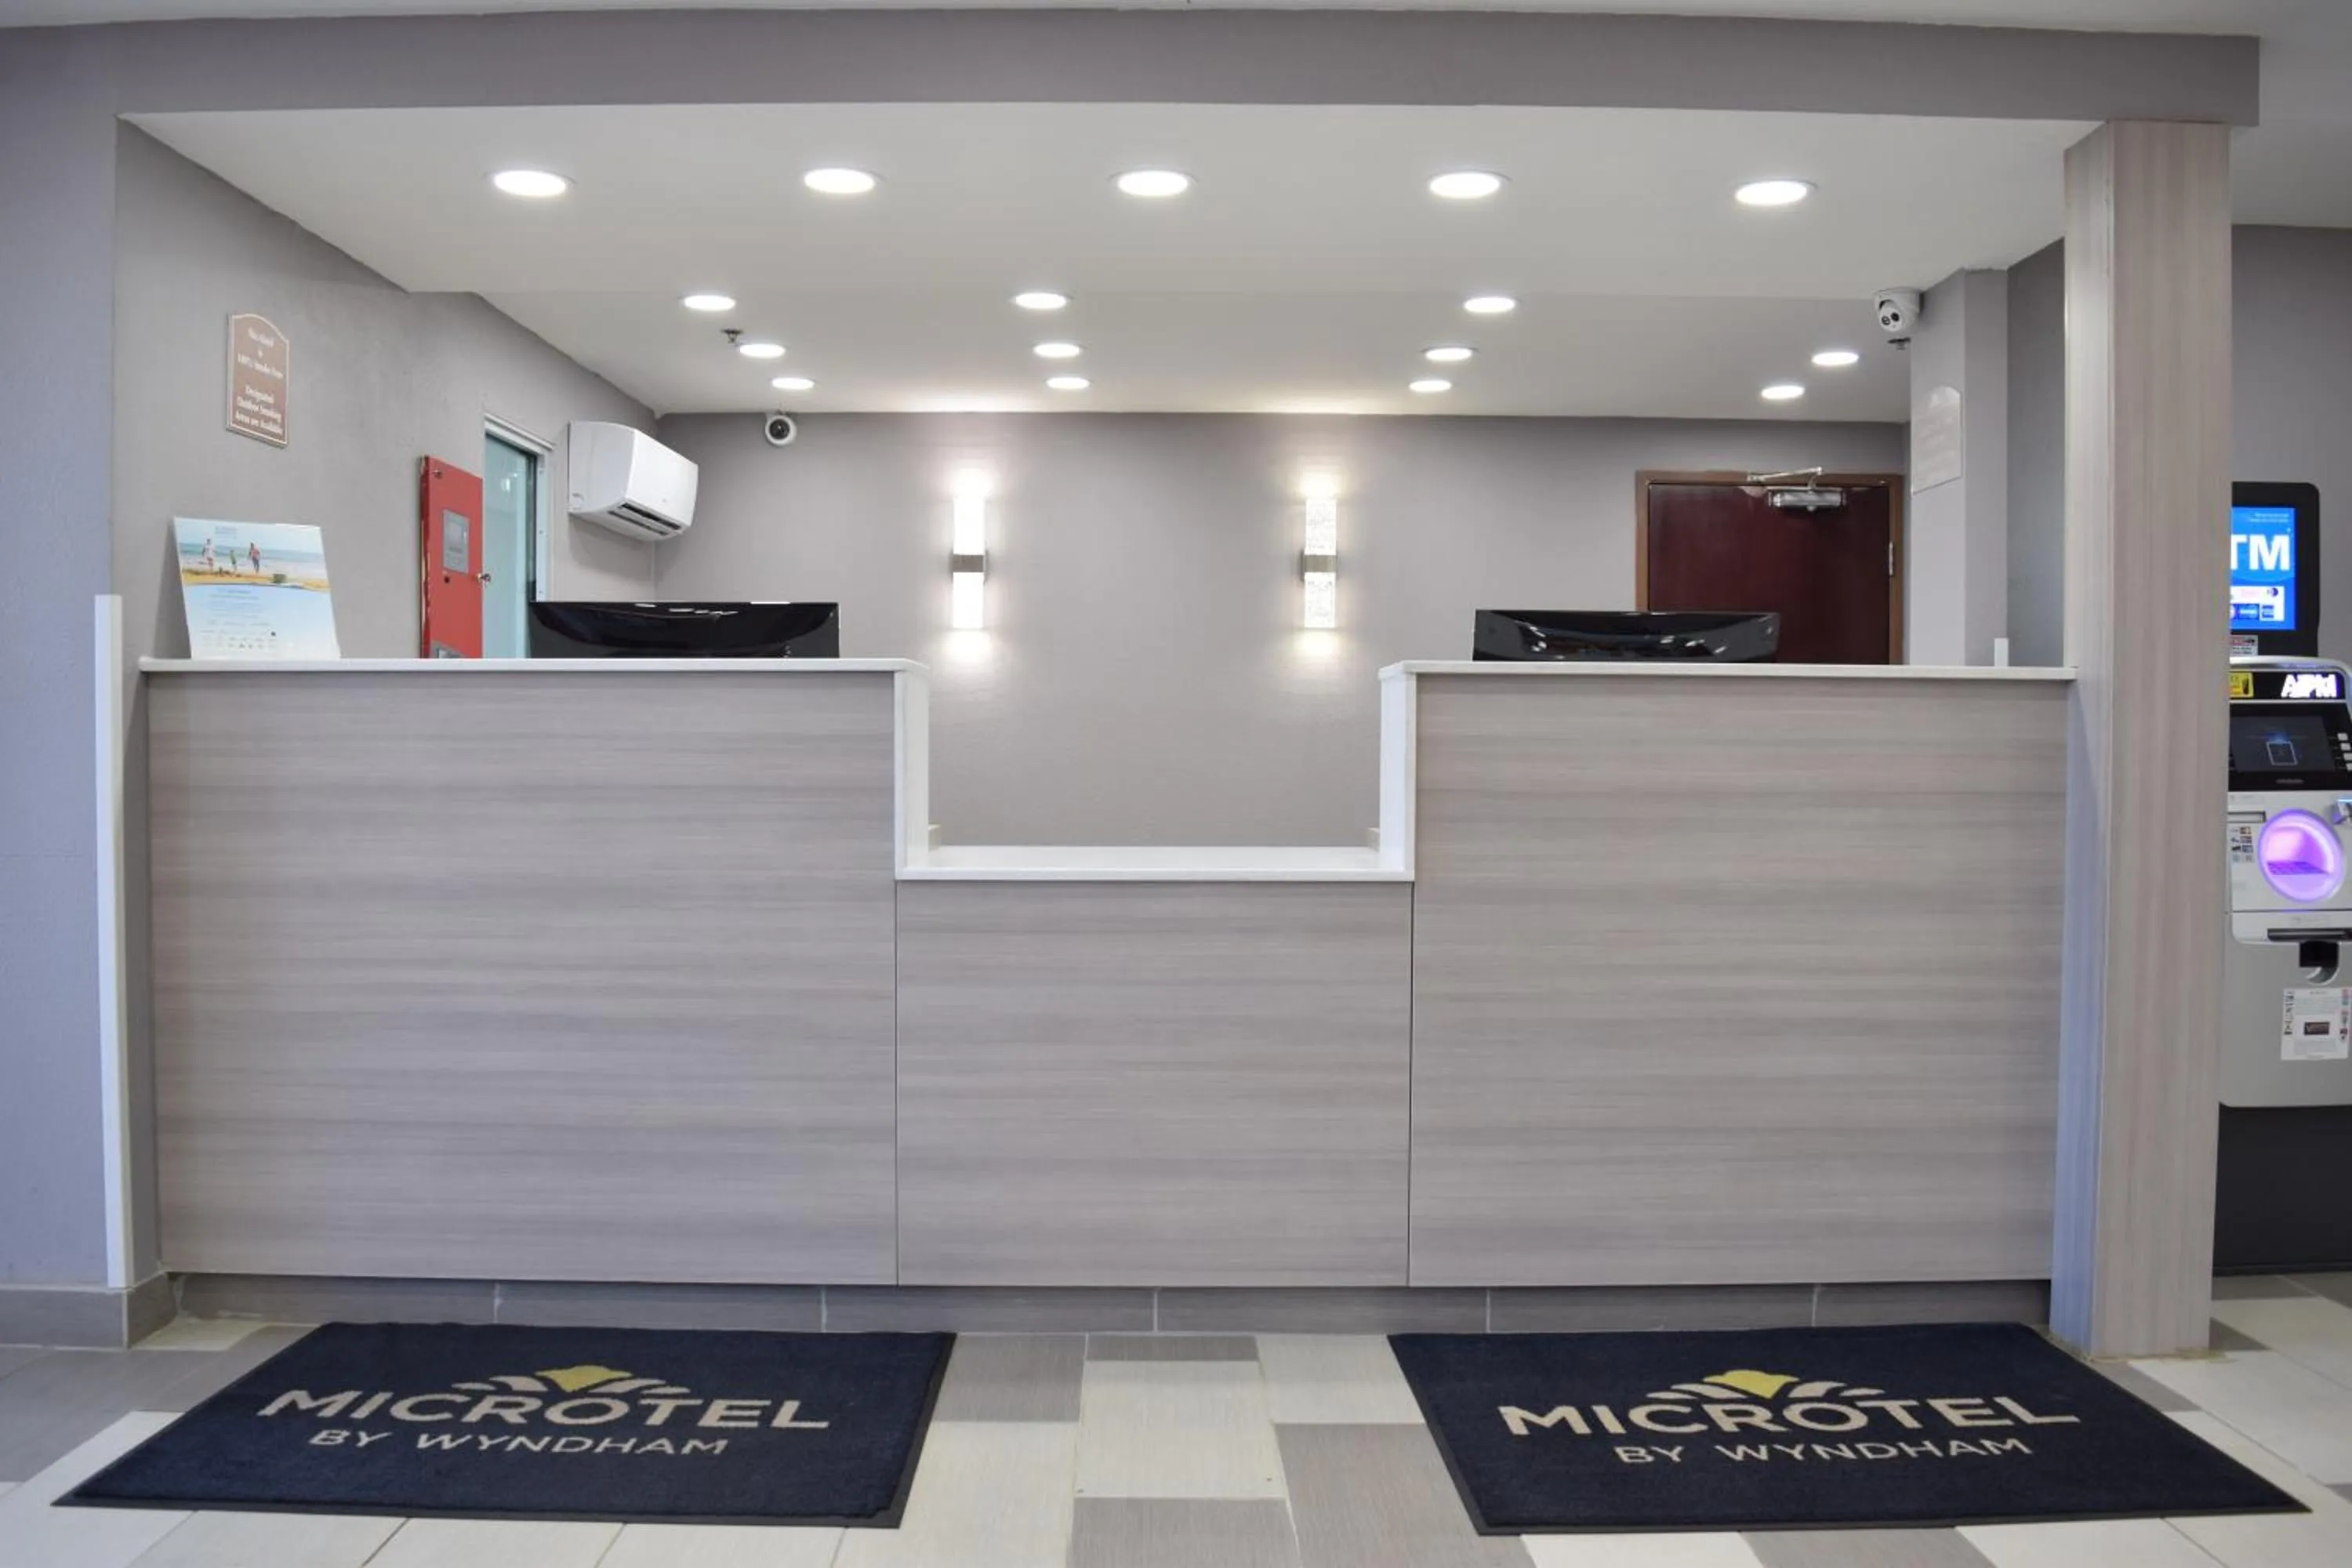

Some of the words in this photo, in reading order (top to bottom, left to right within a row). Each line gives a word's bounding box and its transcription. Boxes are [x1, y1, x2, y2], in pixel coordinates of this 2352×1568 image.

[2230, 534, 2290, 571] TM
[258, 1390, 829, 1428] MICROTEL
[1498, 1396, 2080, 1436] MICROTEL
[310, 1429, 390, 1447] BY
[416, 1433, 728, 1455] WYNDHAM
[1614, 1446, 1683, 1463] BY
[1715, 1439, 2032, 1461] WYNDHAM
